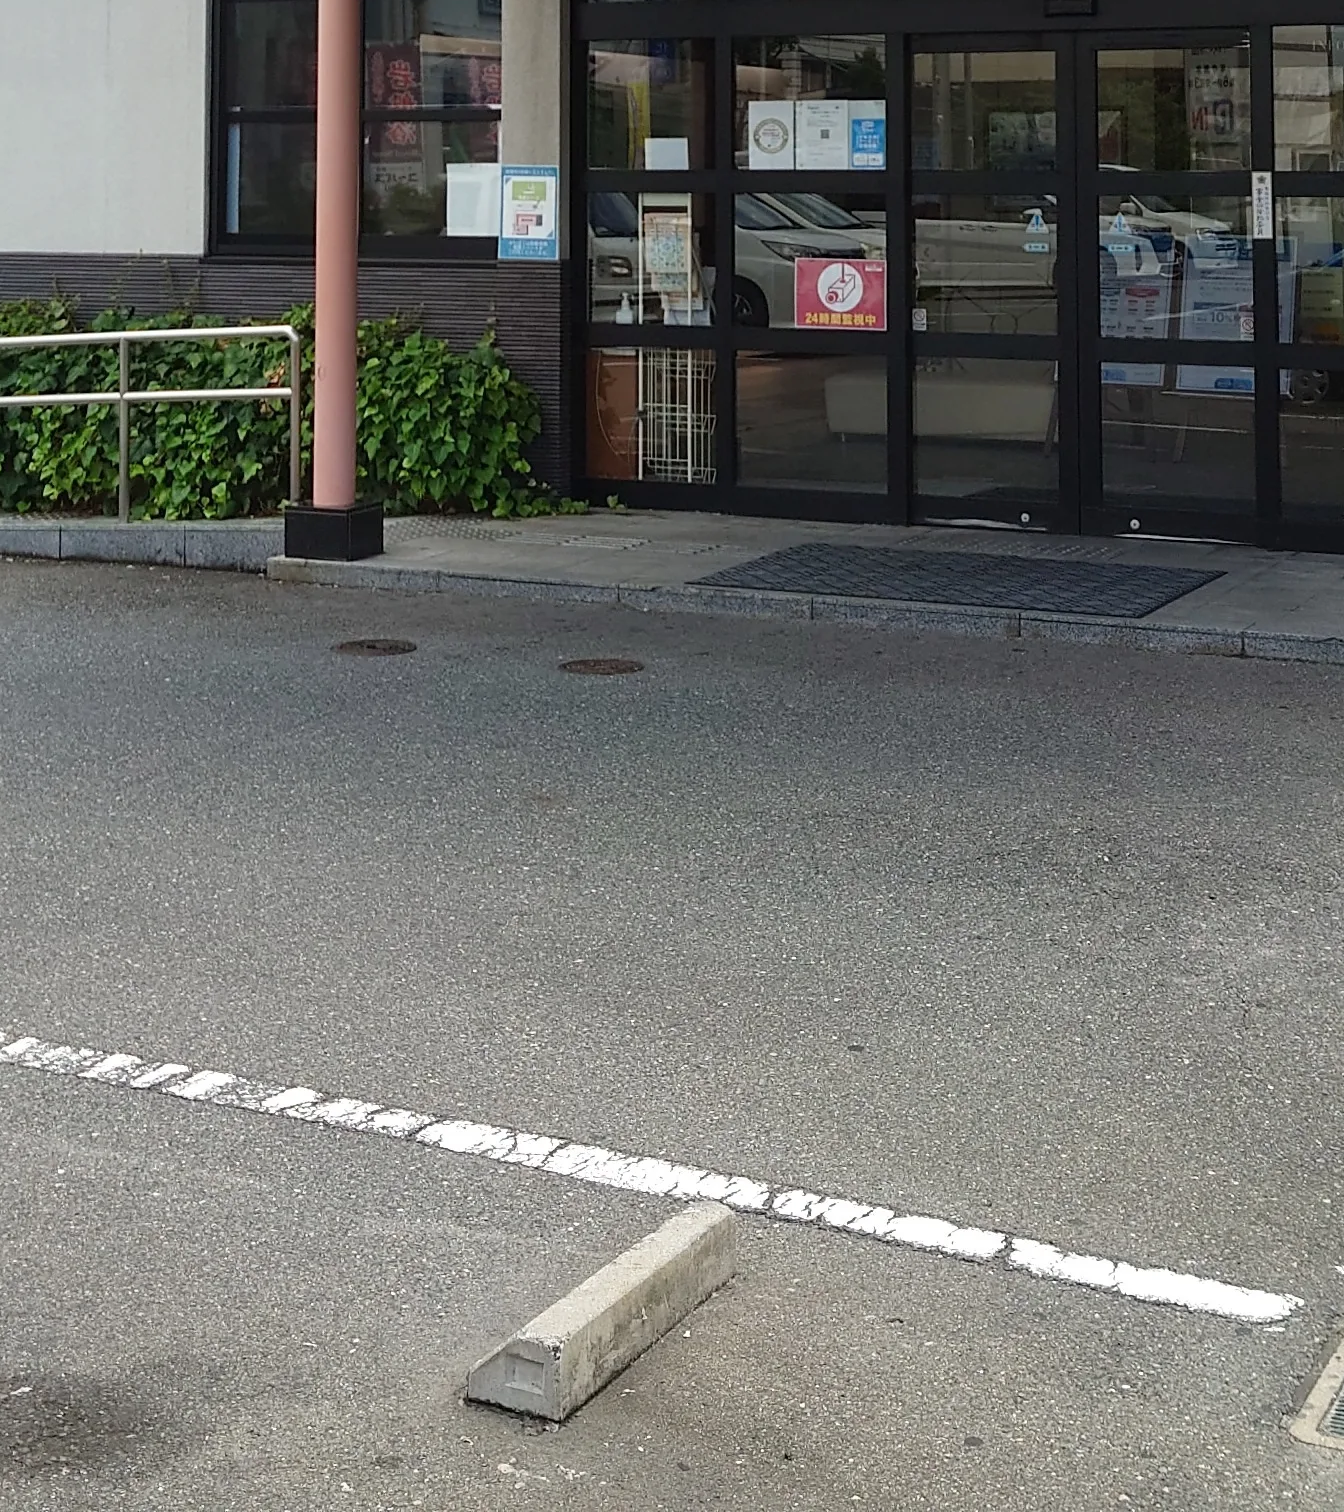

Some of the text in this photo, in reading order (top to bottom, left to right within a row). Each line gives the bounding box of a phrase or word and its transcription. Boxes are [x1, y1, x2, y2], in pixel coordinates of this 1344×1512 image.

[805, 312, 877, 327] 24時間監視中
